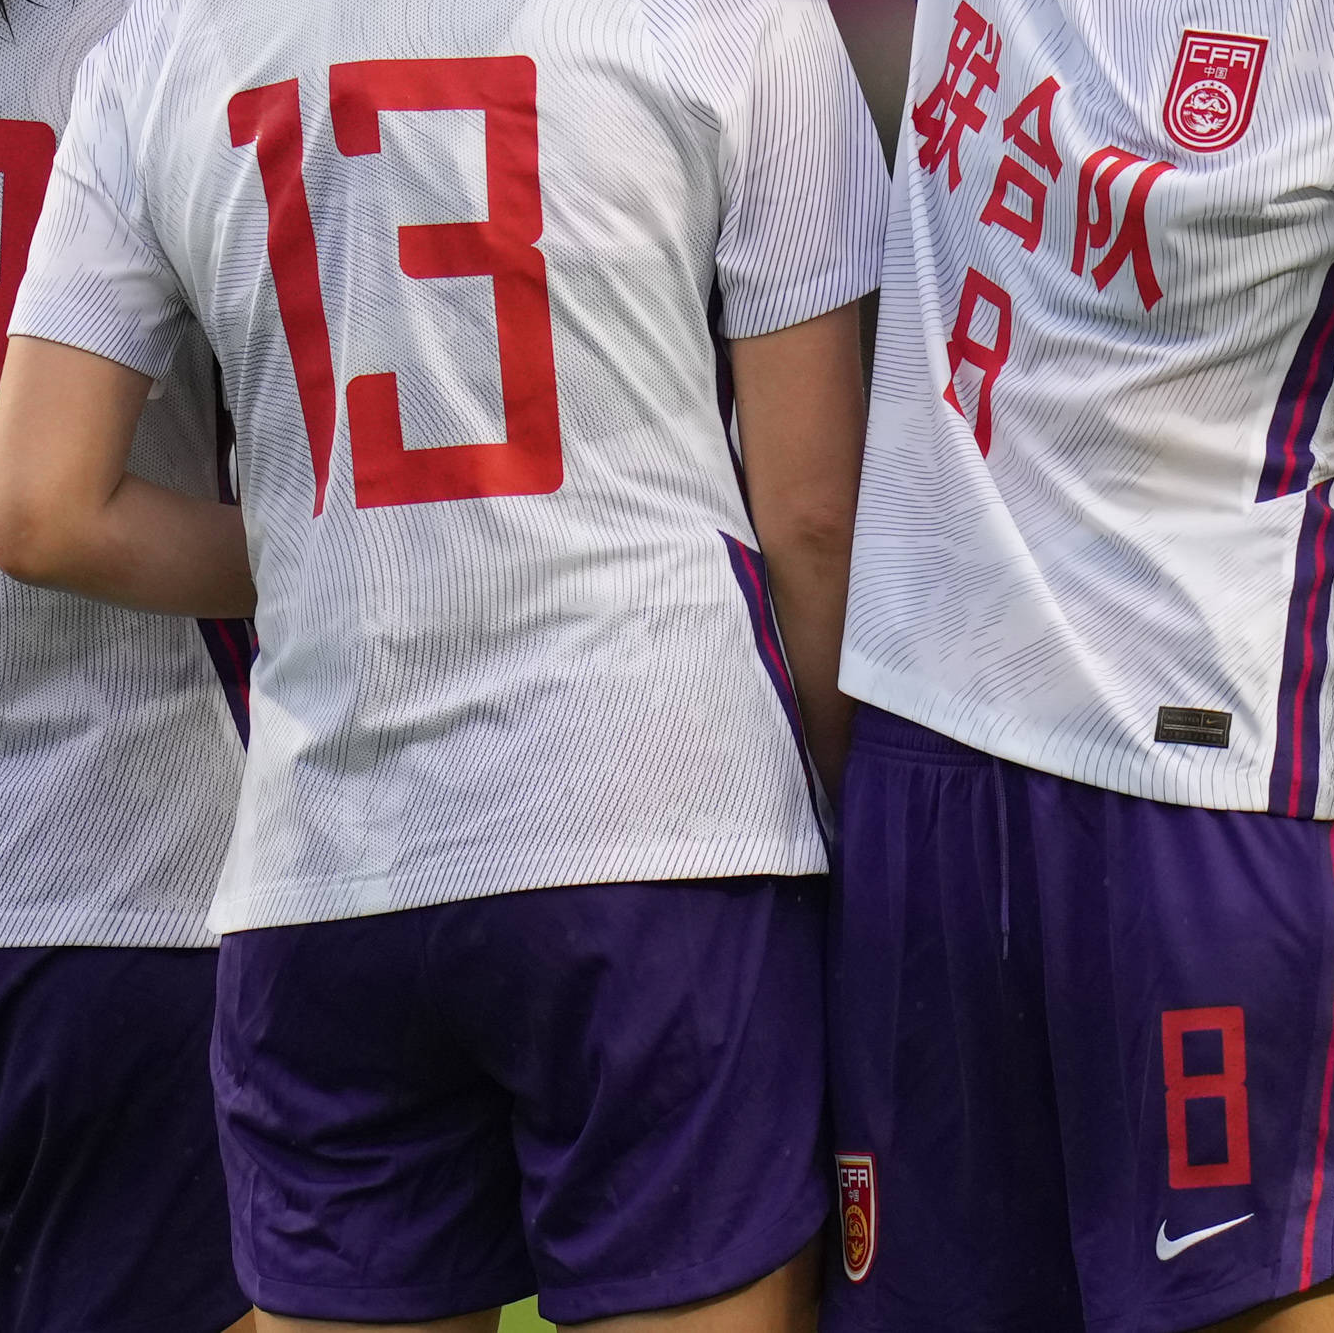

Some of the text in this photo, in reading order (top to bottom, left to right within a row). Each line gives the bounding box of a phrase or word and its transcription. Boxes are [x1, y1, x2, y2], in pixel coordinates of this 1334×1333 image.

[1188, 45, 1251, 69] CFA
[1204, 66, 1228, 80] 中国
[911, 0, 1178, 313] 联合队
[227, 55, 564, 519] 13
[942, 266, 1012, 459] 8
[841, 1168, 868, 1188] CFA
[1162, 1005, 1251, 1189] 8
